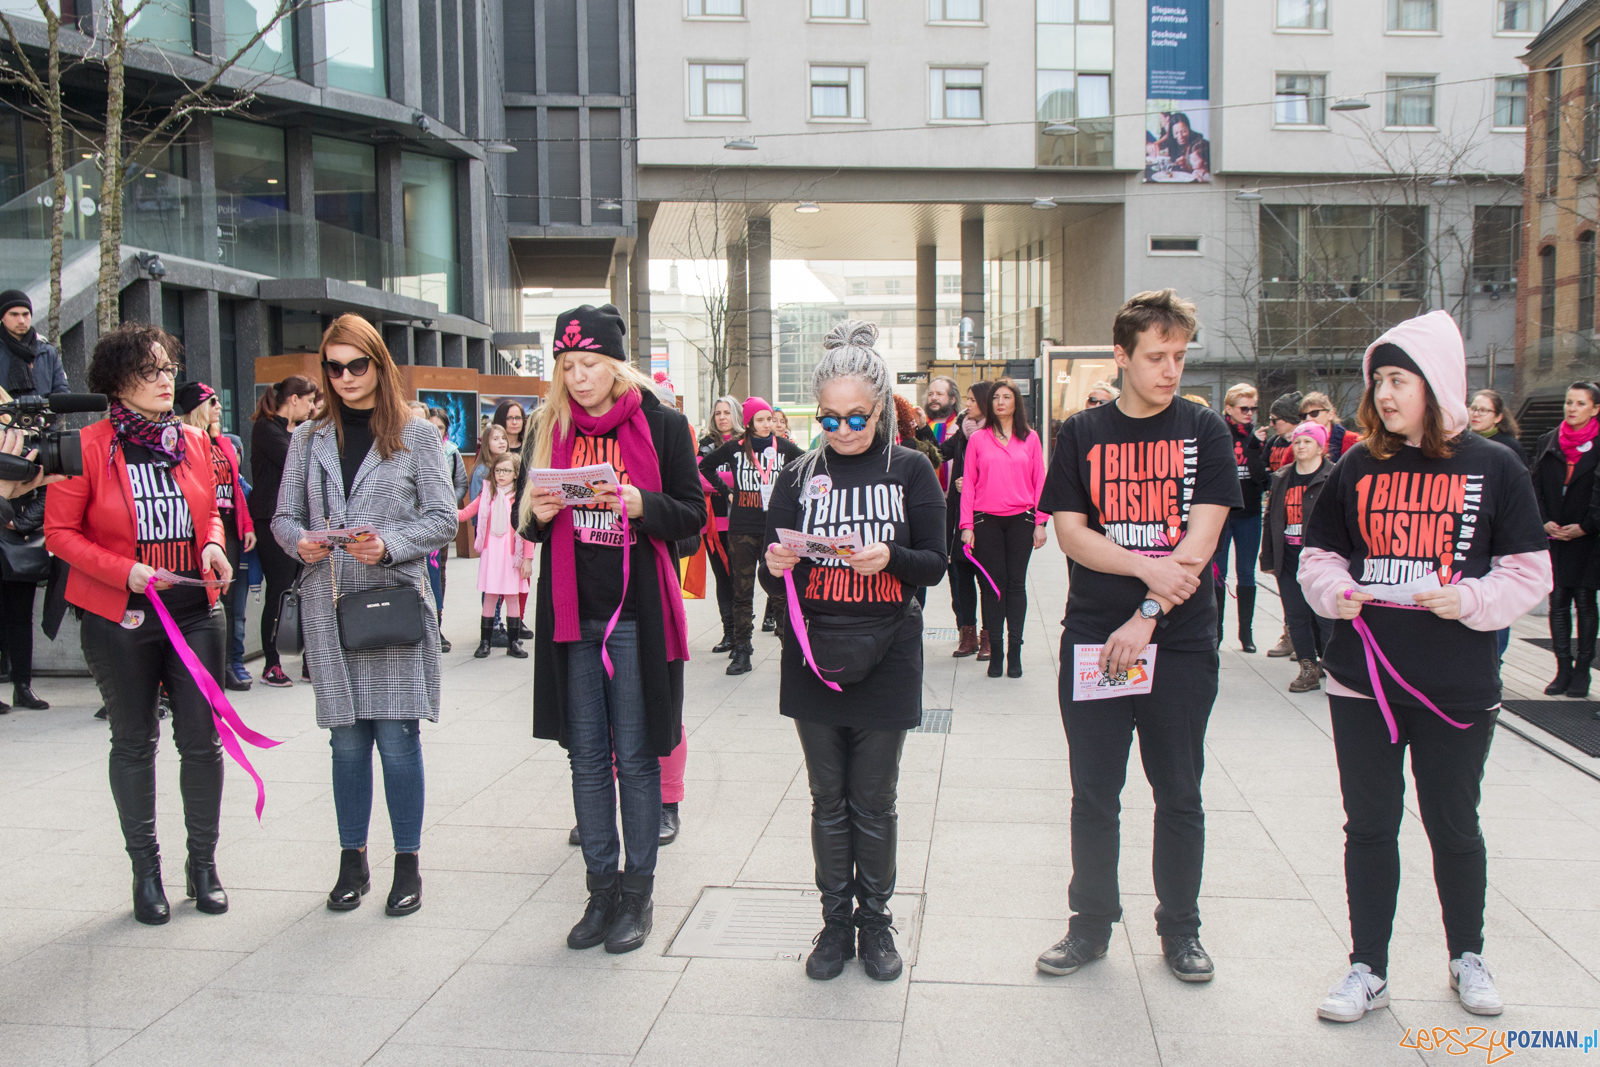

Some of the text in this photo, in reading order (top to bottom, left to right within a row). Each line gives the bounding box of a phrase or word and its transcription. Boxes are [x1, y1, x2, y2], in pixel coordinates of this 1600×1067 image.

[570, 435, 627, 472] BILLIO
[814, 483, 905, 525] BILLION
[1087, 440, 1185, 526] 1 BILLION
[1105, 479, 1178, 523] RISING
[1101, 522, 1165, 547] EVOLUTION
[1355, 471, 1468, 560] 1 BILLION
[1369, 512, 1455, 559] RISING
[805, 566, 903, 603] REVOLUTION
[1079, 669, 1101, 682] TAK
